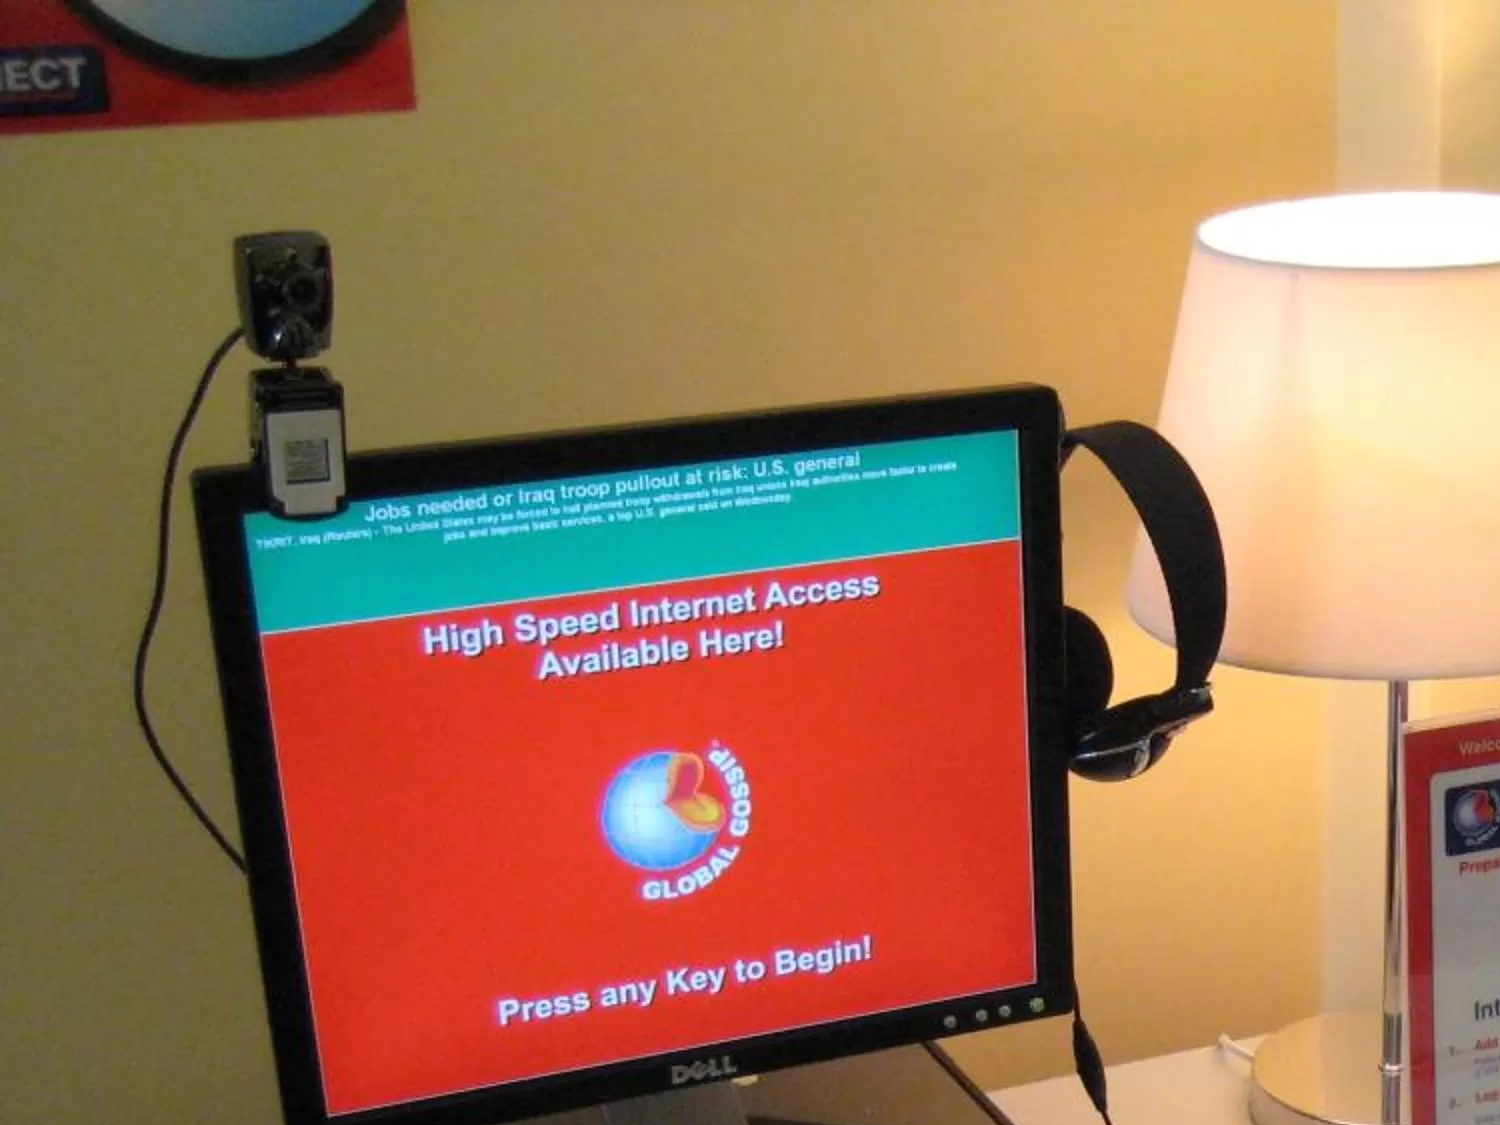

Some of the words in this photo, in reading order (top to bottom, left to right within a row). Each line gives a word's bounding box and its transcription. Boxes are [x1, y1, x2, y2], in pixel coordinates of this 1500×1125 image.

[0, 57, 87, 93] ECT
[364, 504, 411, 523] Jobs
[417, 495, 488, 517] needed
[493, 491, 513, 507] or
[518, 485, 555, 506] Iraq
[561, 481, 611, 501] troop
[616, 473, 680, 496] pullout
[686, 471, 702, 487] at
[708, 464, 748, 483] risk:
[754, 459, 790, 477] U.S.
[795, 451, 861, 477] general
[423, 621, 503, 658] High
[514, 604, 620, 646] Speed
[630, 586, 756, 627] Internet
[764, 575, 880, 609] Access
[537, 636, 689, 680] Available
[700, 622, 785, 658] Here!
[708, 747, 752, 838] GOSSIP
[642, 845, 741, 900] GLOBAL
[499, 986, 592, 1026] Press
[600, 977, 657, 1008] any
[667, 964, 726, 998] Key
[735, 956, 767, 983] to
[776, 935, 873, 976] Begin!
[671, 1058, 738, 1085] DELL
